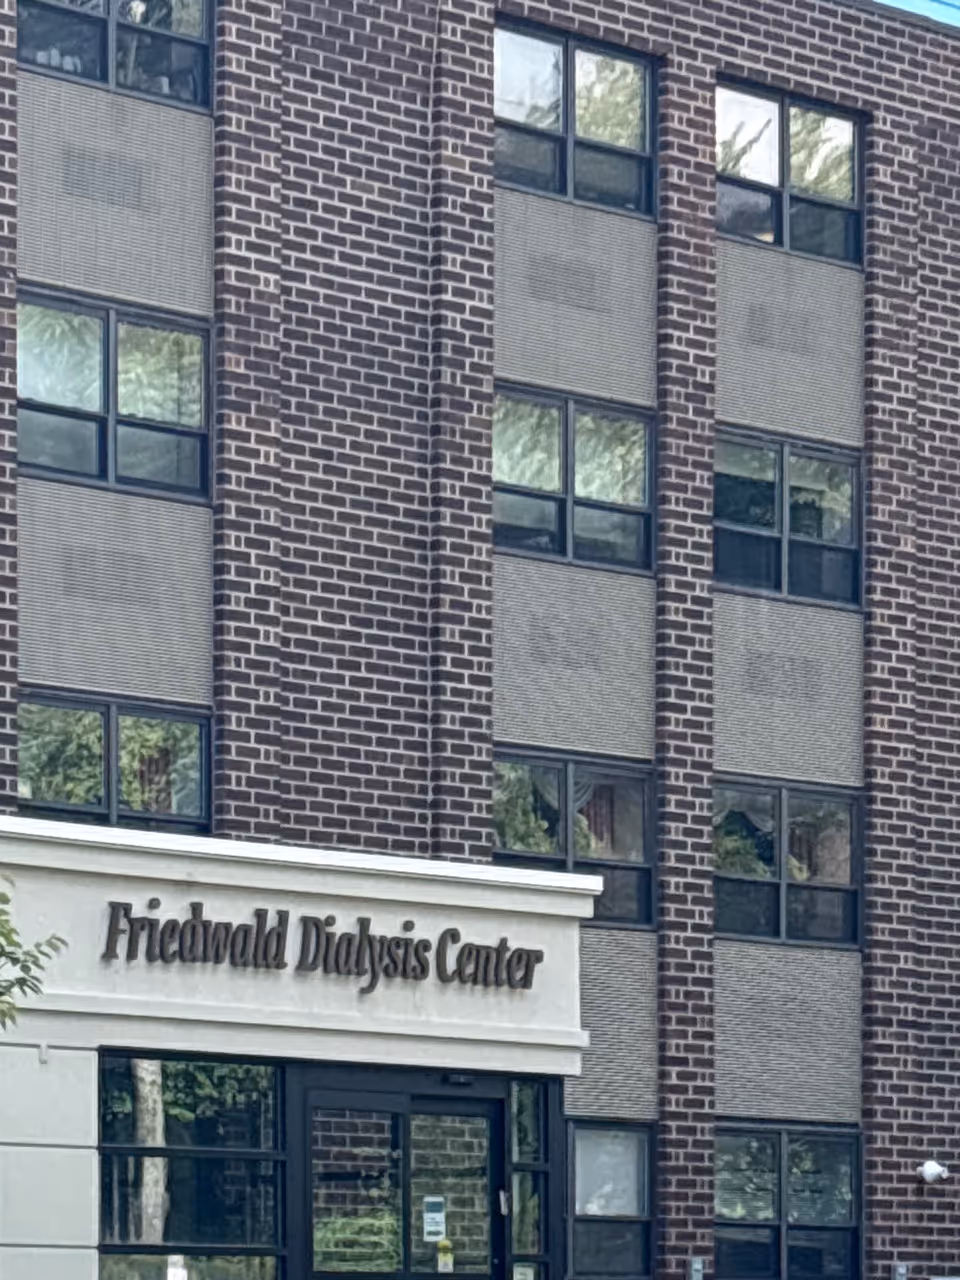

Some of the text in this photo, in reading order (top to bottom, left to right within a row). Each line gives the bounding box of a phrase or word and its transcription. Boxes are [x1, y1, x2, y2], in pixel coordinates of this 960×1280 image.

[100, 897, 544, 994] Friedwald Dialysis Center
